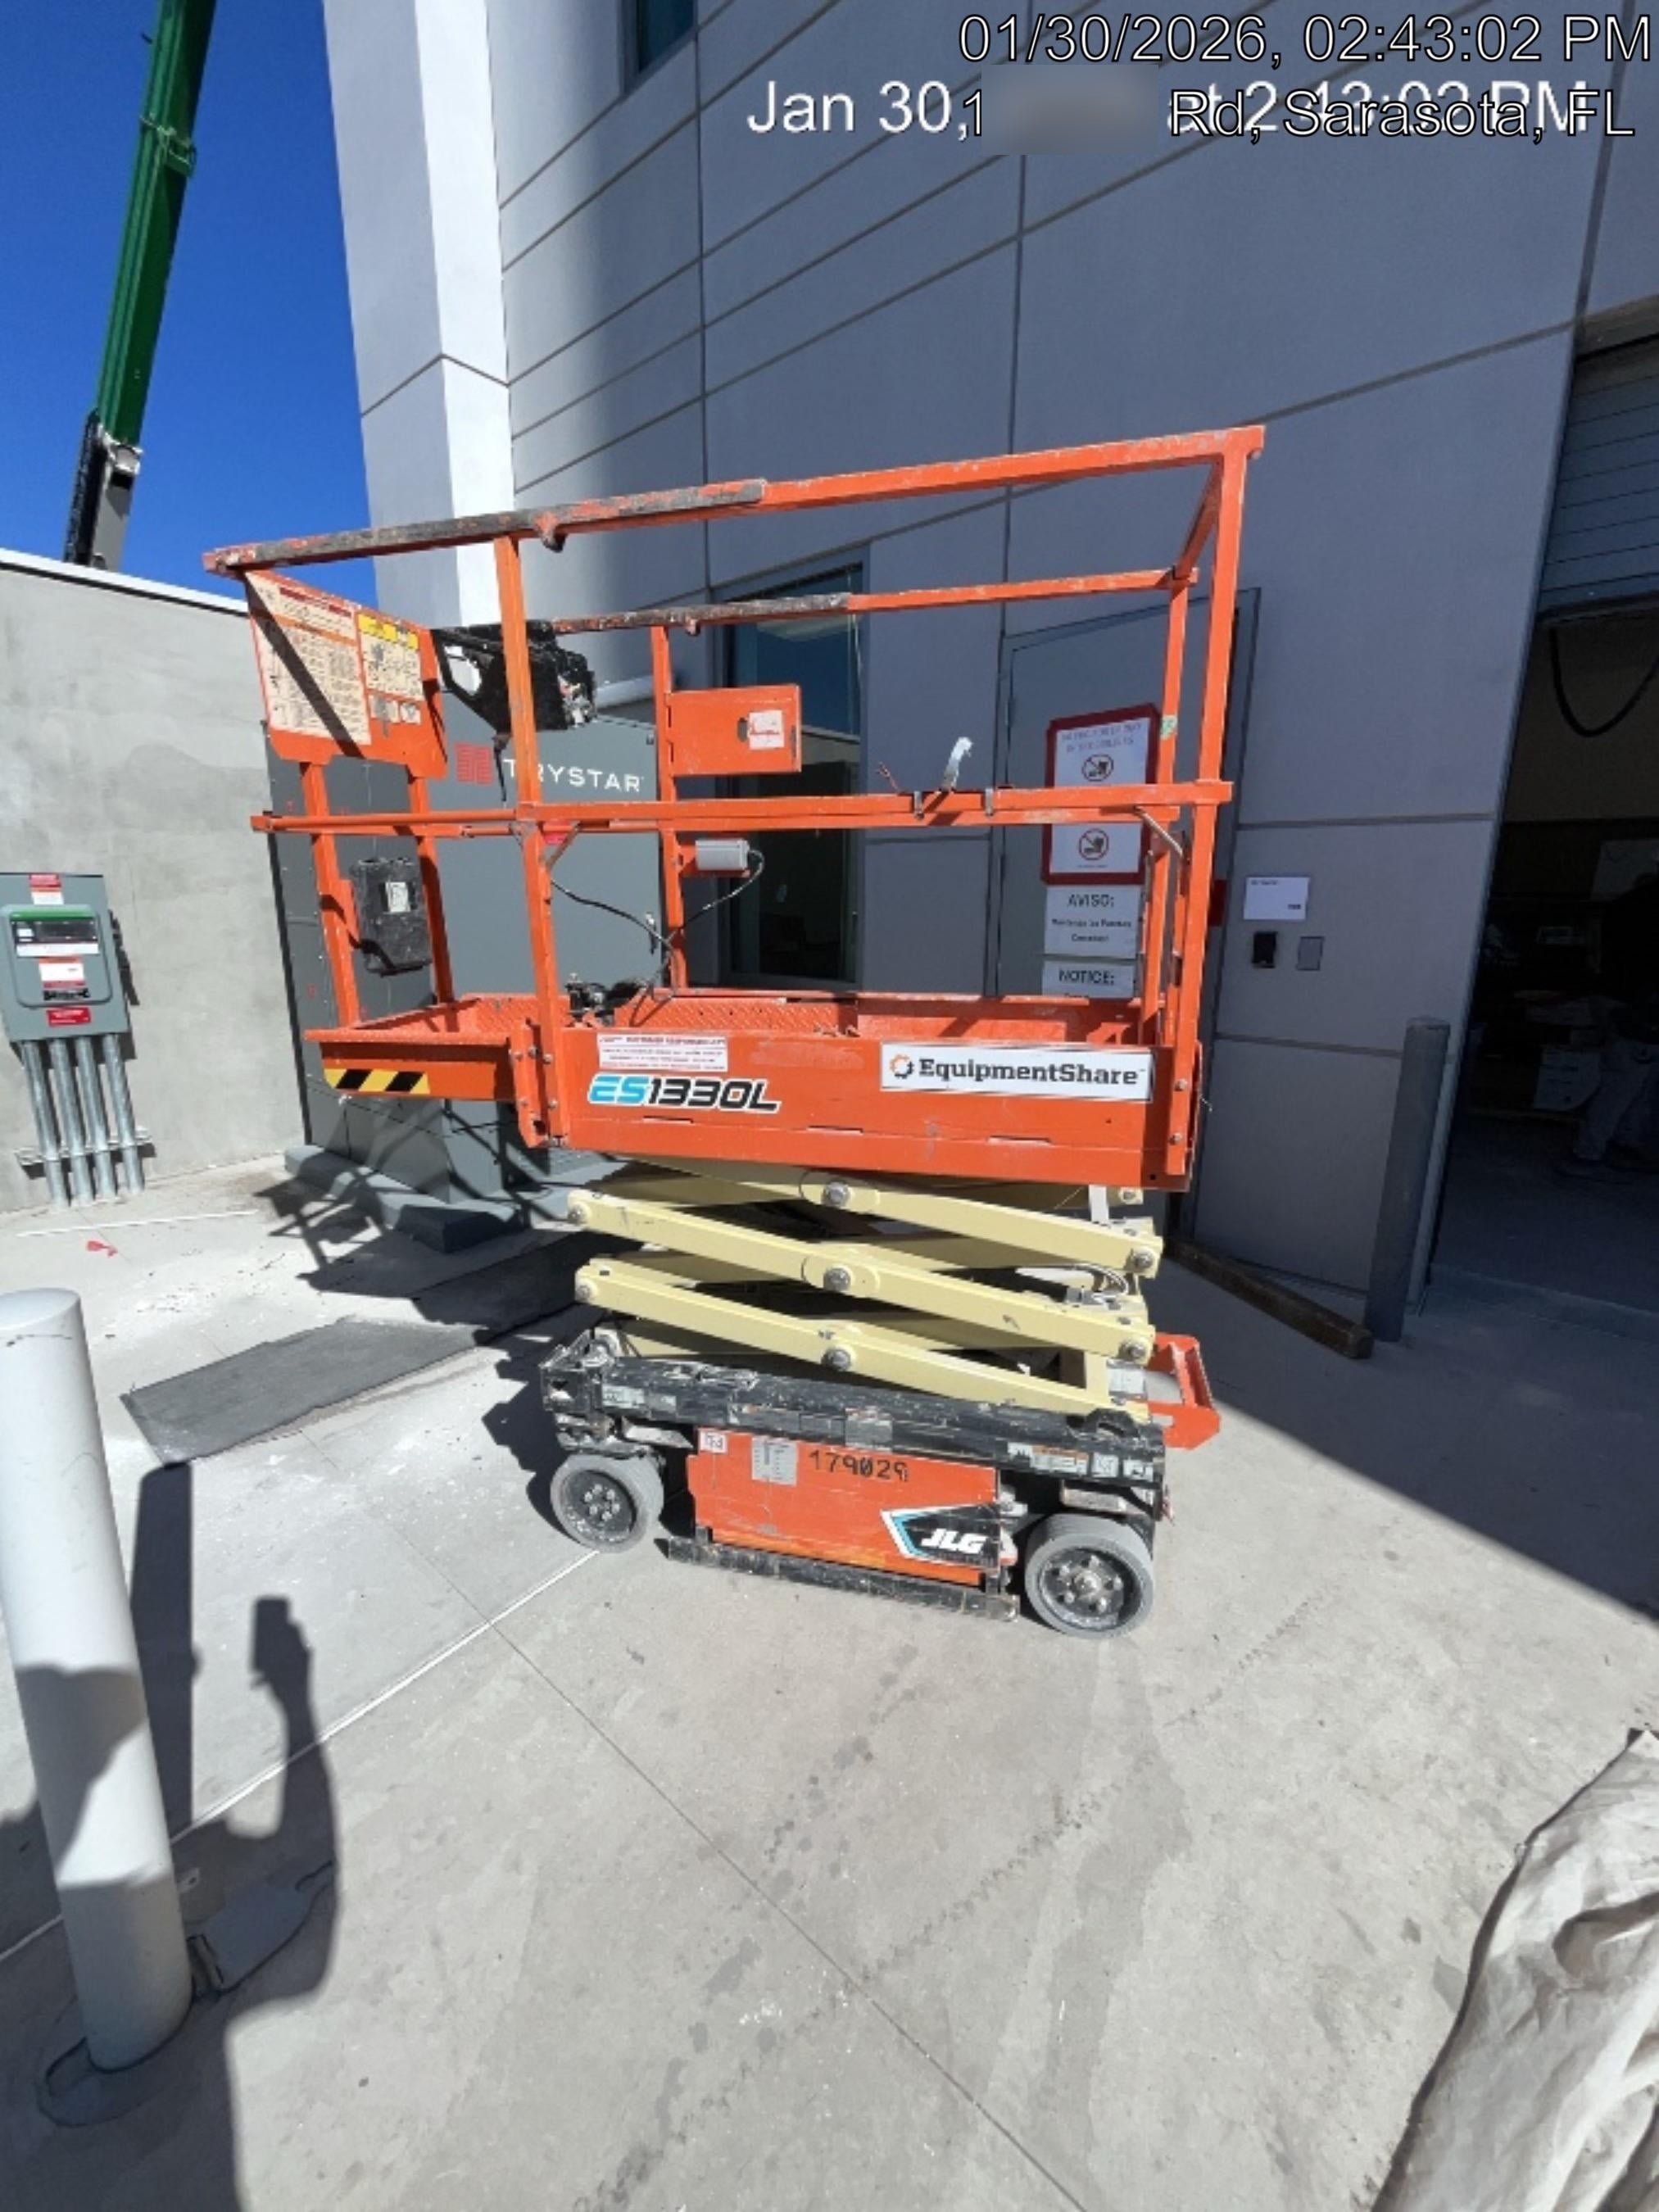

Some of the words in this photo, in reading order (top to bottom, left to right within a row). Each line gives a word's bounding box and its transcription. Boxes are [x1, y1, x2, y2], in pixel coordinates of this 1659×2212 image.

[1058, 970, 1115, 986] NOTICE:
[919, 1058, 1139, 1086] EquipmentShare
[588, 1075, 779, 1112] ES1330L
[921, 1528, 990, 1554] JLG
